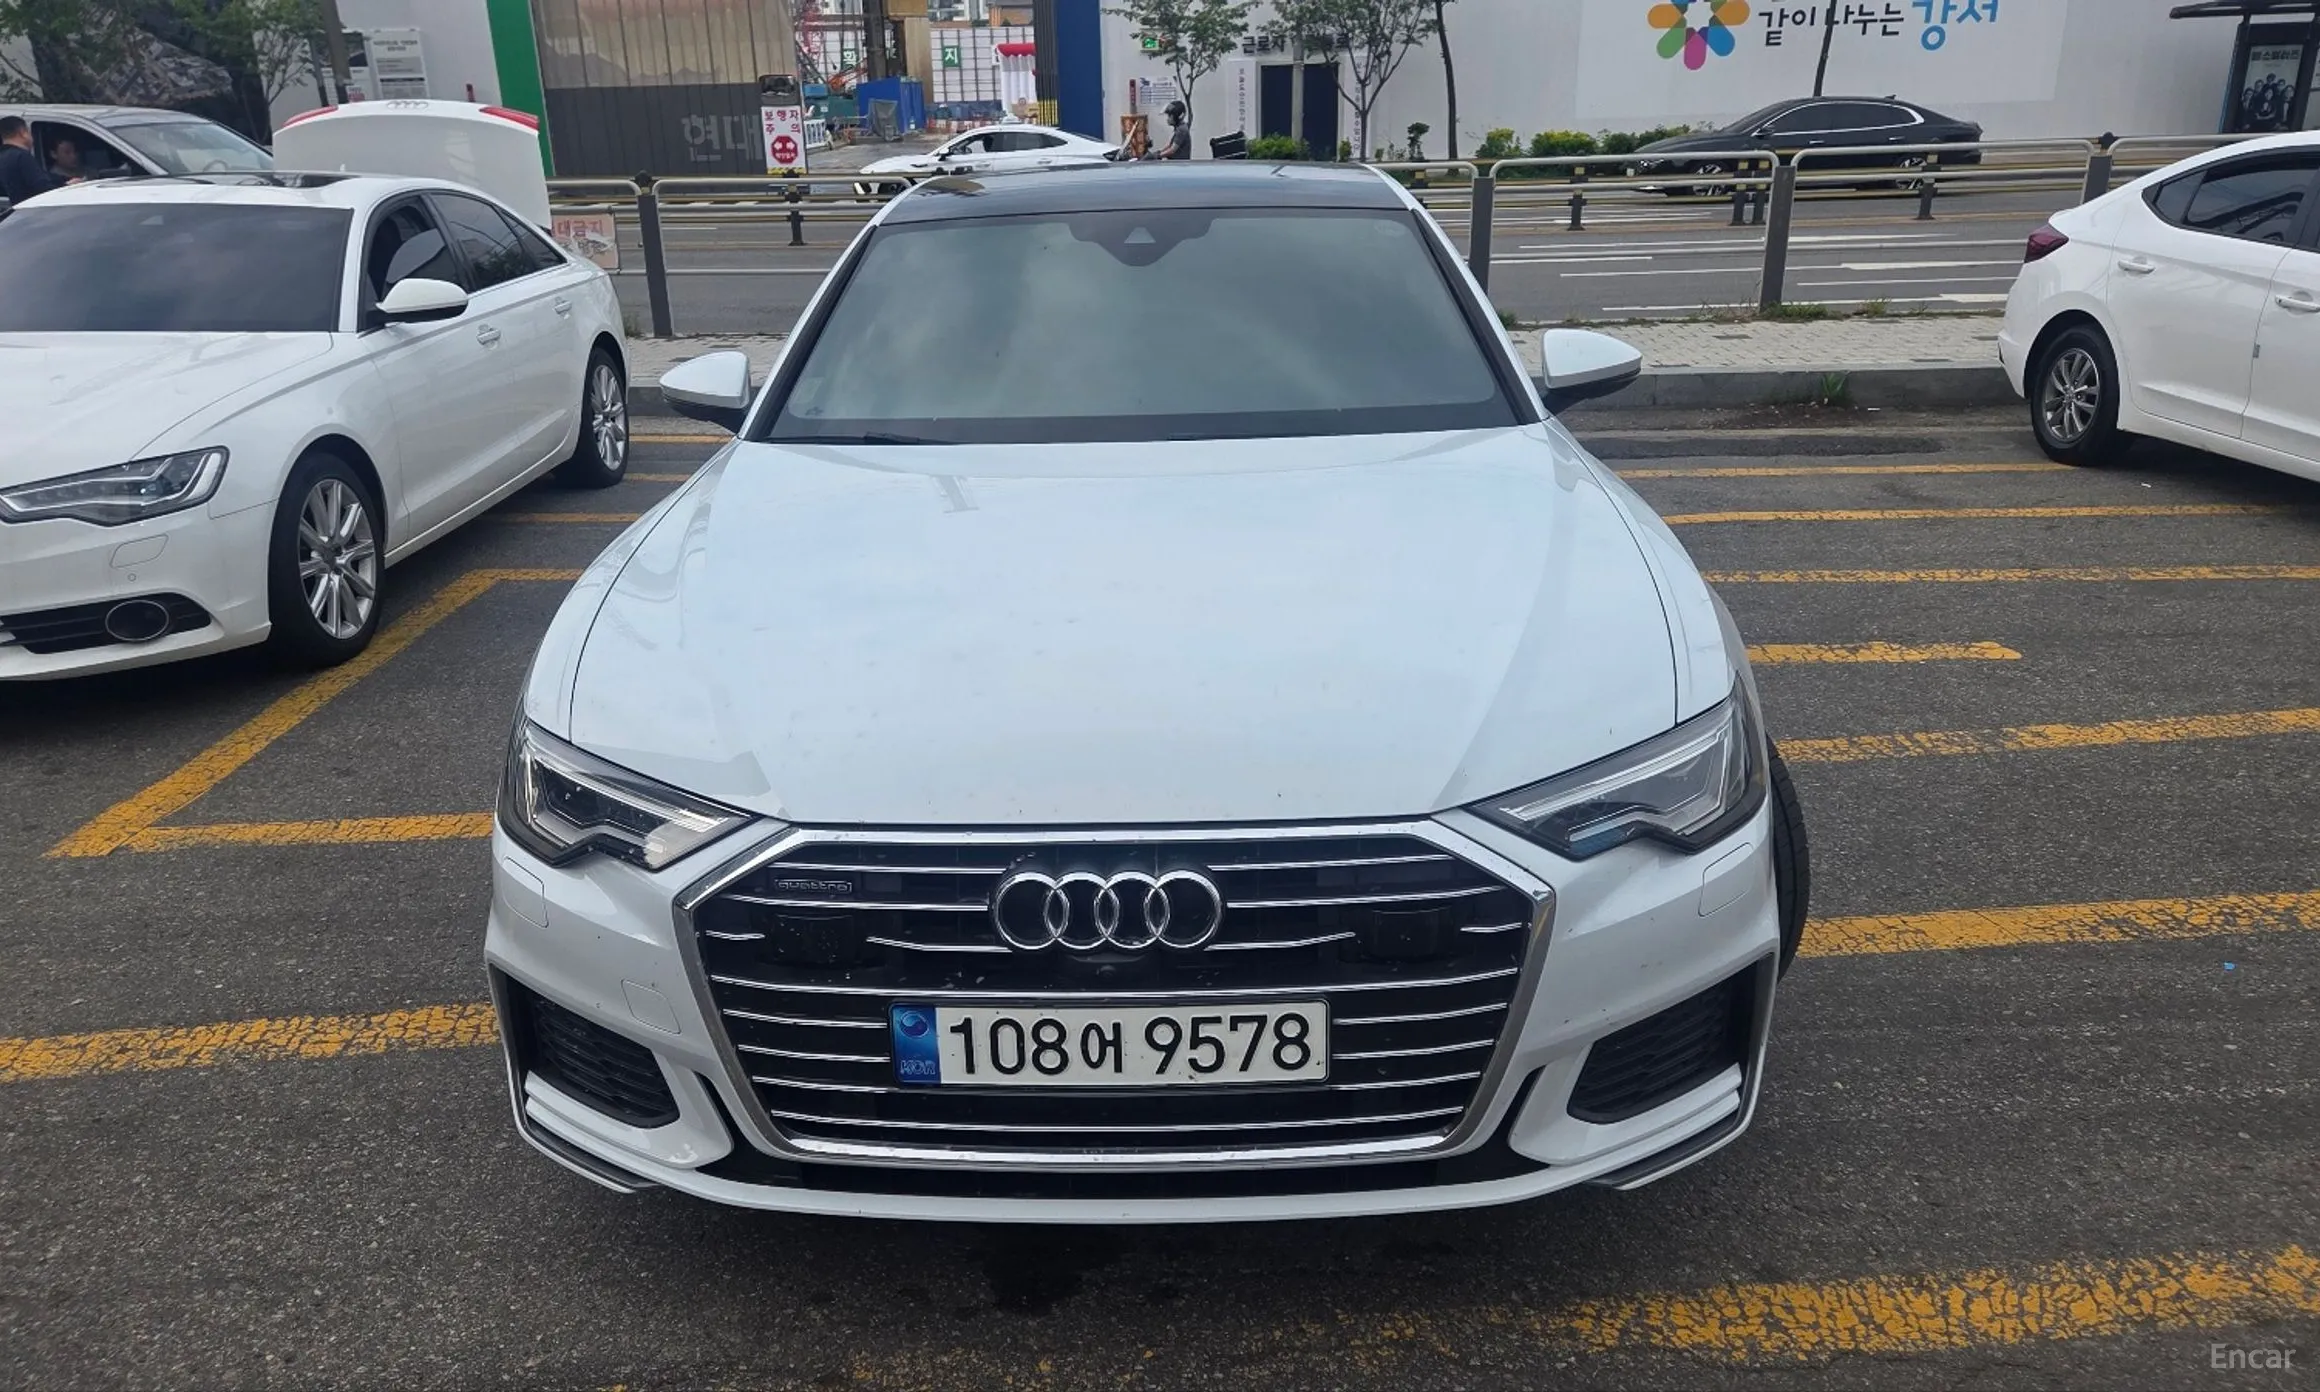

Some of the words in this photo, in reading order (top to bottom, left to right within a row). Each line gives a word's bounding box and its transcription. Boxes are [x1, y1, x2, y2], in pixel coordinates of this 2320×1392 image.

[1759, 6, 1815, 46] 같이
[1825, 4, 1904, 36] 나누는
[1912, 0, 1998, 51] 강서
[1242, 35, 1286, 54] 근로자
[945, 47, 959, 64] 지
[764, 109, 799, 121] 보행자
[681, 114, 763, 161] 현대
[765, 123, 800, 136] 주의
[777, 880, 850, 892] quattro
[900, 1058, 936, 1076] KOR
[949, 1015, 1123, 1076] 108어
[1143, 1012, 1312, 1076] 9578
